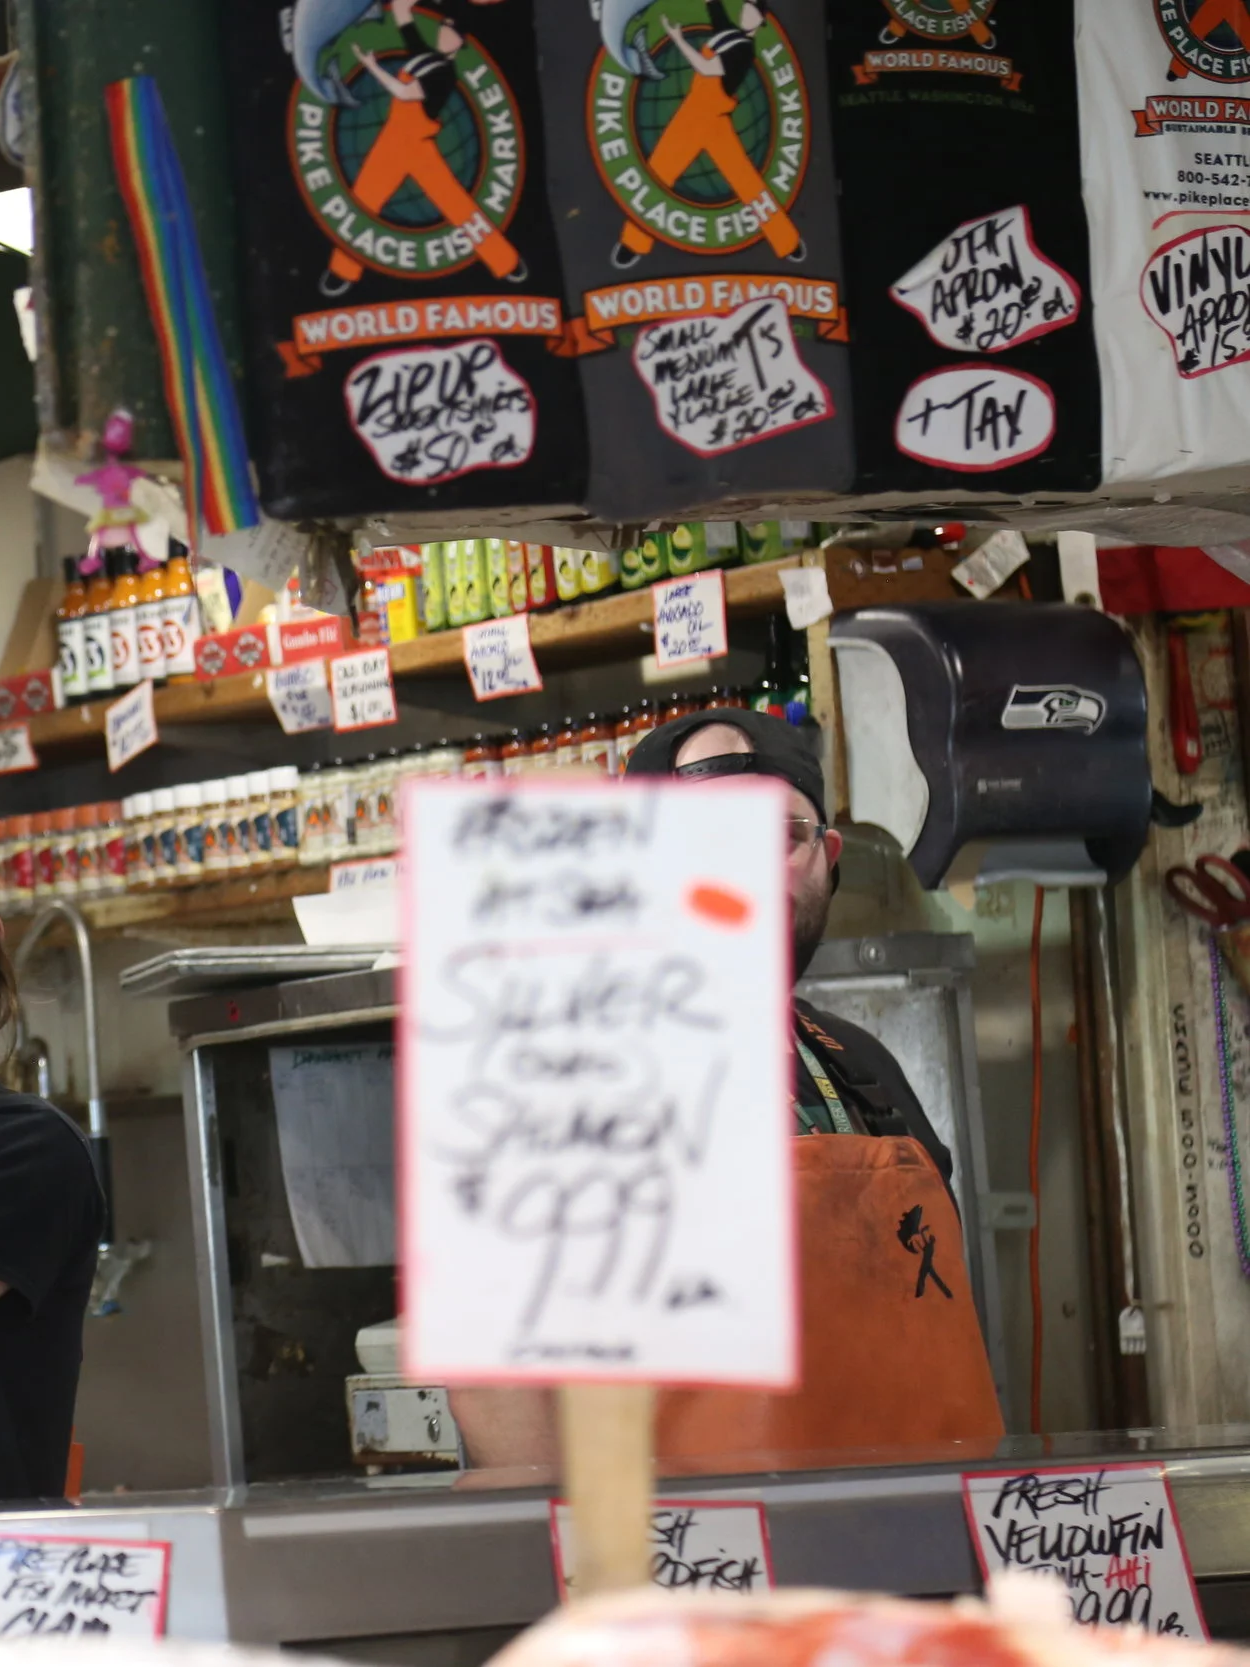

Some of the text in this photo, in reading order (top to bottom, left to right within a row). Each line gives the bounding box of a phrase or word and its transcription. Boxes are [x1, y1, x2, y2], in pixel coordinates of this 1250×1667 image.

[943, 9, 978, 33] FISH
[867, 52, 1010, 76] WORLD FAMOUS
[1169, 26, 1224, 74] PLACE
[1152, 100, 1220, 119] WORLD
[1164, 123, 1237, 135] SUSTAINABLE
[595, 43, 802, 243] PIKE PLACE FISH MARKET
[297, 63, 518, 267] PIKE PLACE FISH MARKET
[591, 283, 705, 319] WORLD
[931, 235, 1024, 324] APRON
[301, 301, 558, 344] WORLD FAMOUS
[991, 1469, 1111, 1520] FRESH
